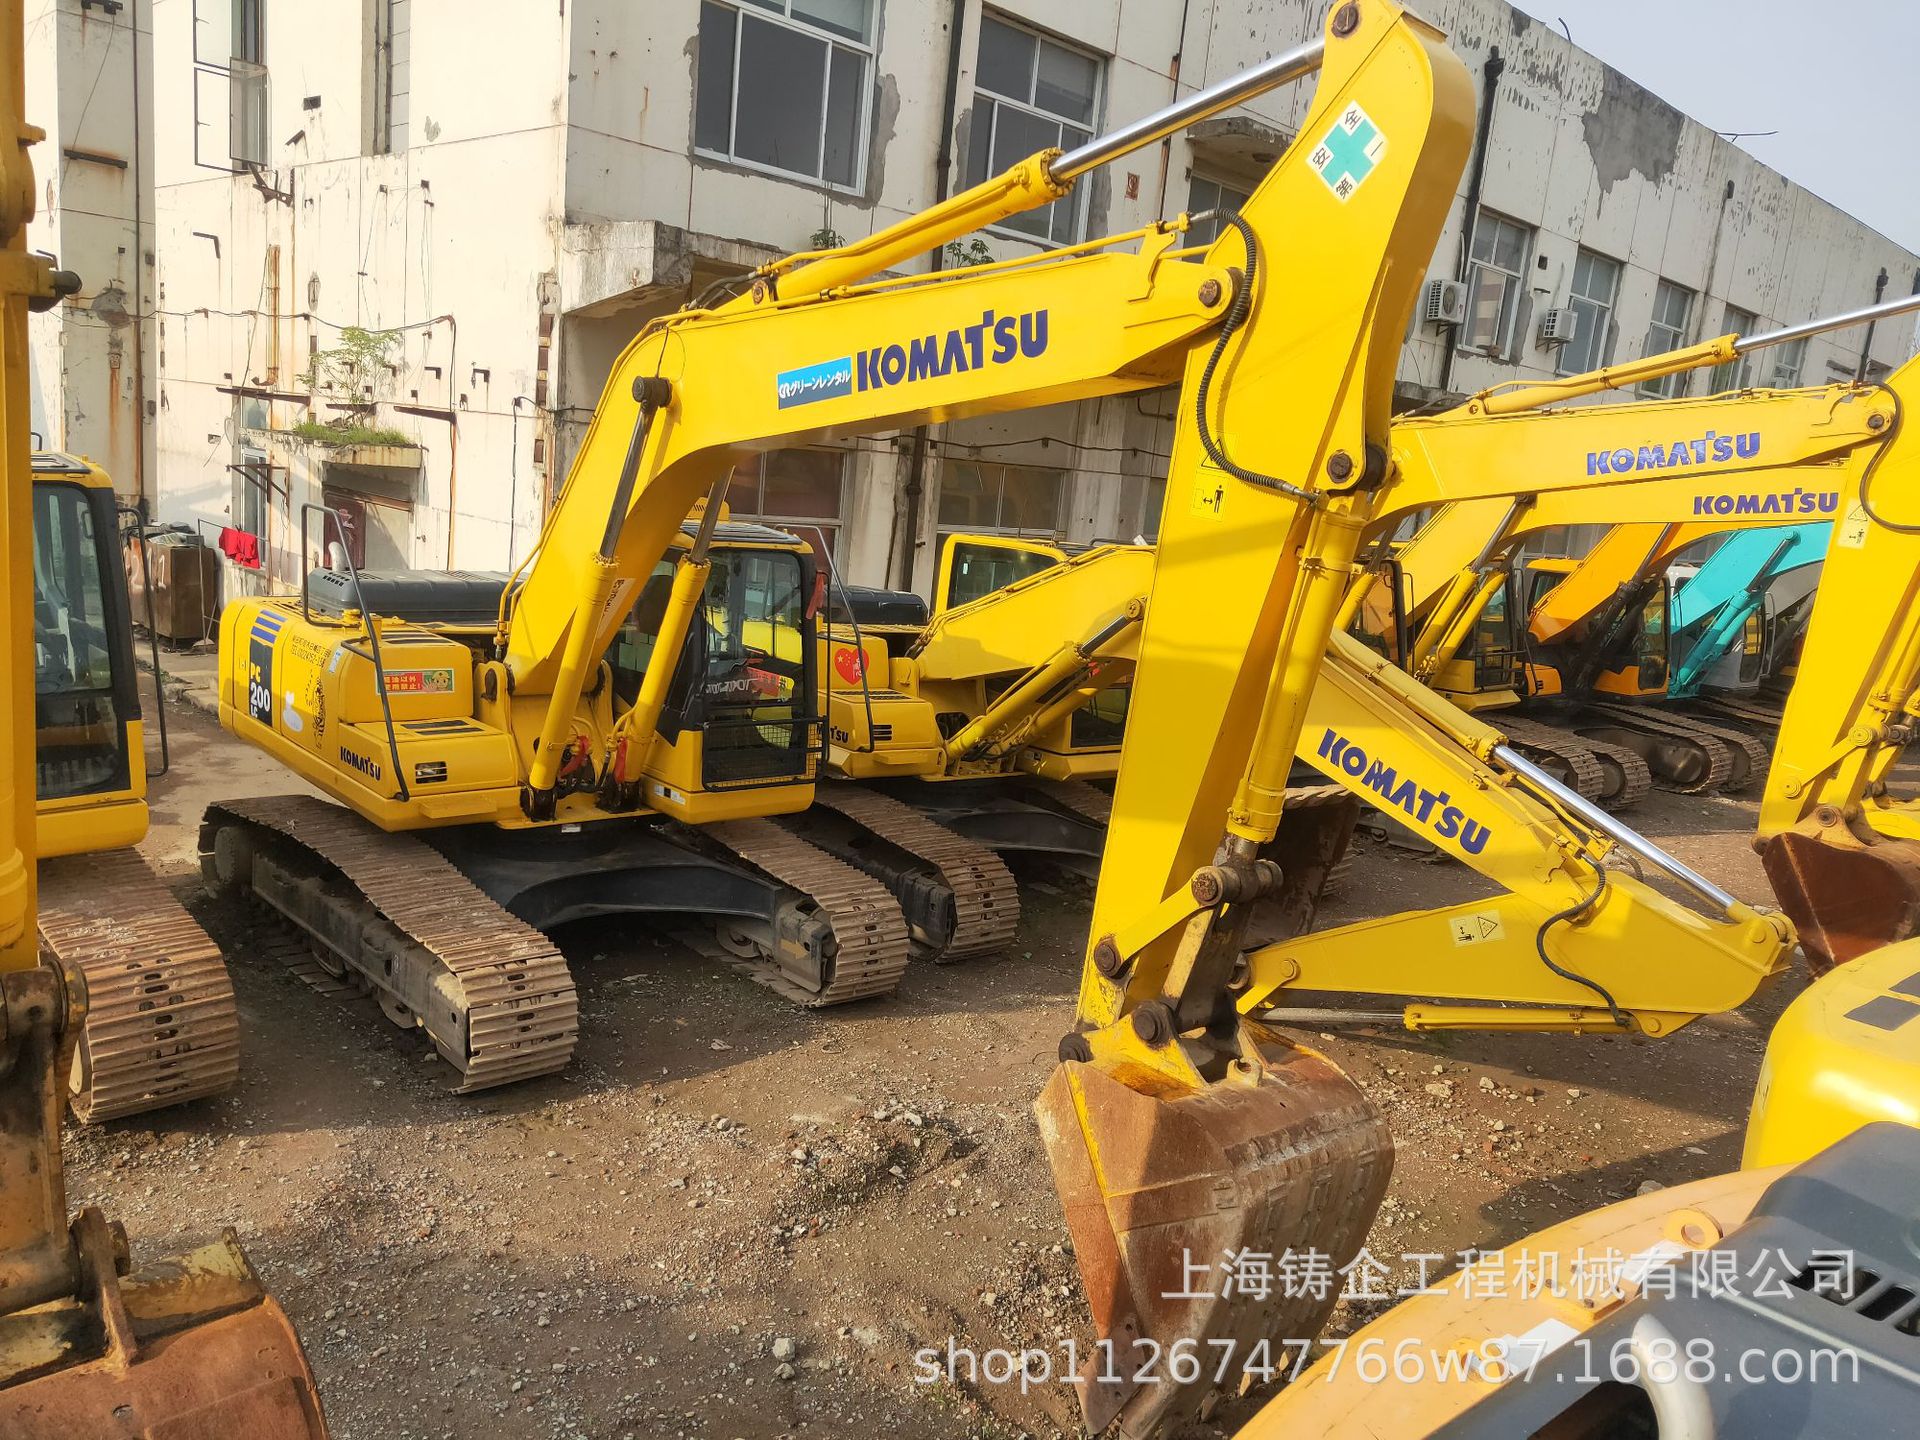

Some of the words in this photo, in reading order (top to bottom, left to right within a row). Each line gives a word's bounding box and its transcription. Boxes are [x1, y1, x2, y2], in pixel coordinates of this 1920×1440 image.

[857, 309, 1048, 392] KOMATSU
[1587, 430, 1760, 476] KOMATSU
[1693, 487, 1839, 515] KOMATSU
[250, 661, 261, 683] PC
[250, 681, 271, 712] 200
[340, 745, 381, 781] KOMATSU
[1317, 727, 1492, 855] KOMATSU
